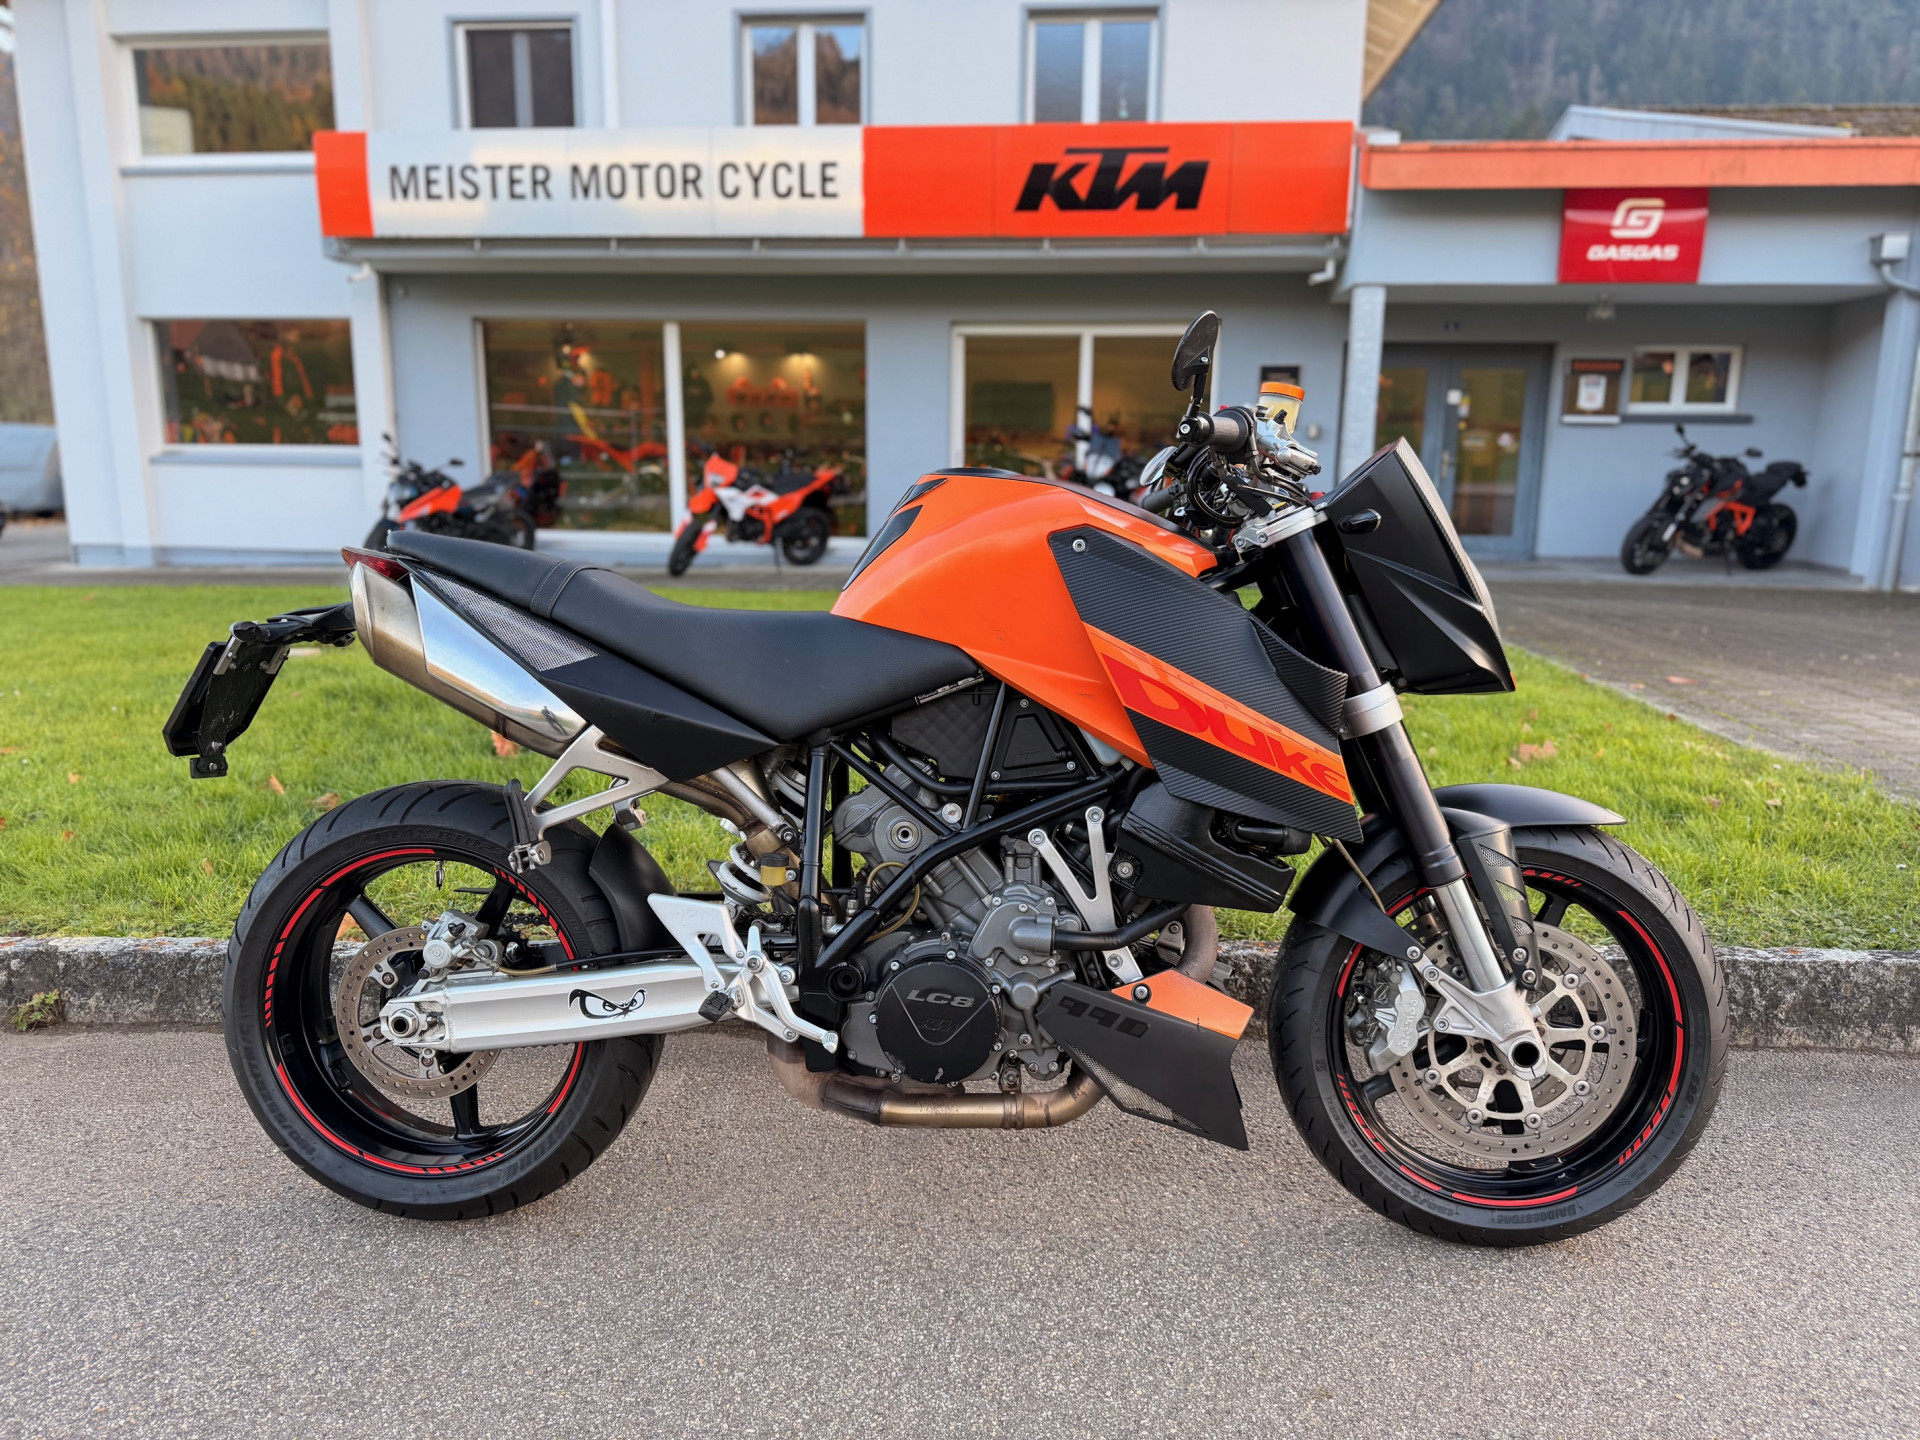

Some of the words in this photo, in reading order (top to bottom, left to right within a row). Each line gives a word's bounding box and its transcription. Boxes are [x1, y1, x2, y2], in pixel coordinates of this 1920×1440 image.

[388, 163, 552, 200] MEISTER
[569, 163, 703, 200] MOTOR
[718, 162, 839, 199] CYCLE
[1014, 147, 1209, 212] KTM
[1586, 243, 1680, 262] GASGAS
[906, 989, 975, 1008] LC8
[1057, 995, 1149, 1038] 990
[1397, 999, 1419, 1049] brembo
